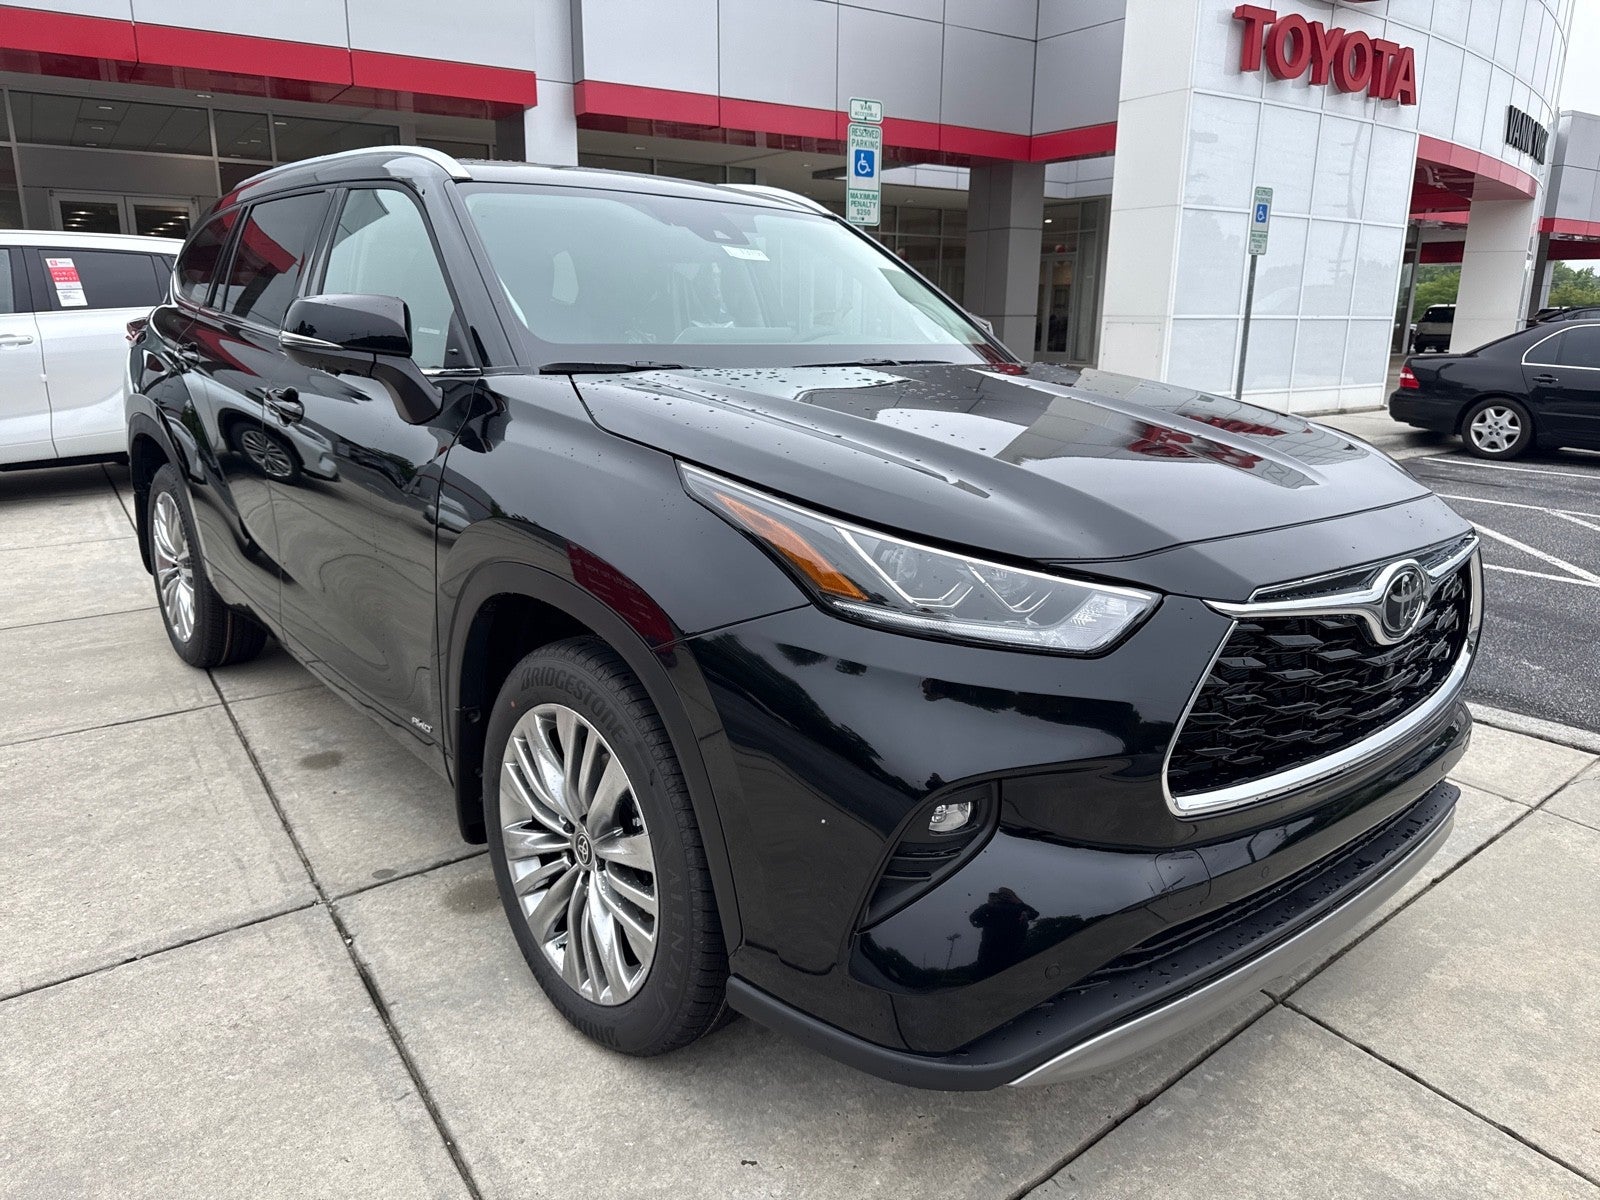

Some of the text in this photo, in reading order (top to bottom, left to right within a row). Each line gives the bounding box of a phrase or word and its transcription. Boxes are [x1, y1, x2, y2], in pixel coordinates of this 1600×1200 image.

[1232, 4, 1417, 106] TOYOTA
[860, 103, 873, 111] VAN
[851, 128, 880, 140] RESERVED
[851, 139, 879, 150] PARKING
[850, 192, 878, 201] MAXIMUM
[850, 200, 877, 209] PENALTY
[856, 208, 871, 217] $250
[520, 666, 629, 744] BRIDGESTONE
[665, 867, 686, 990] ALENZA
